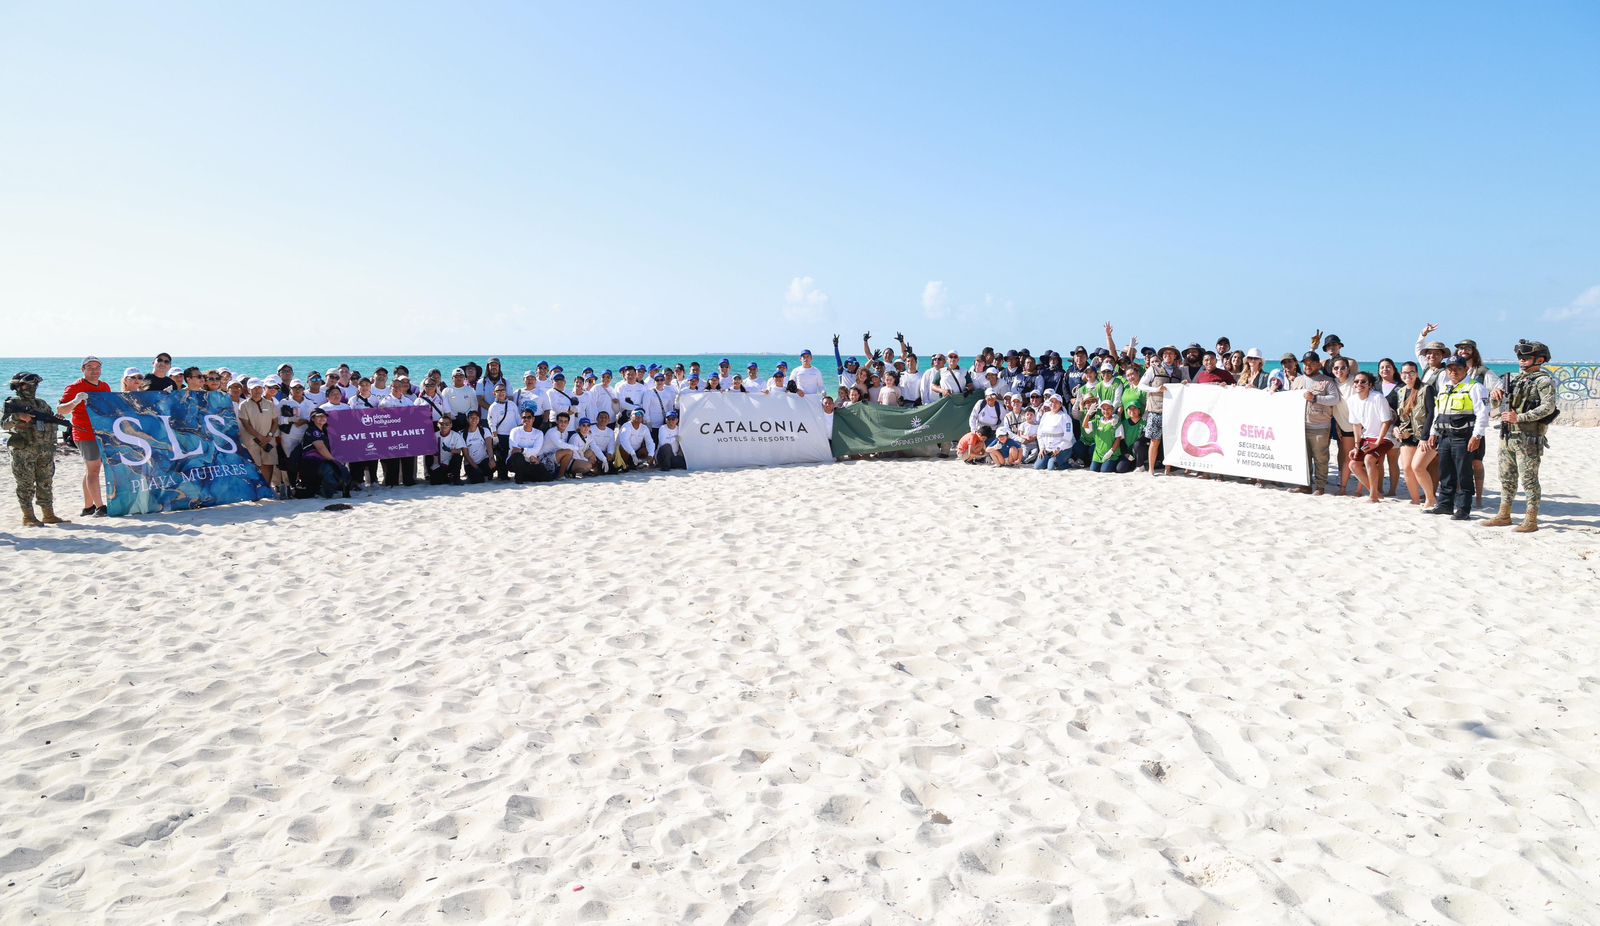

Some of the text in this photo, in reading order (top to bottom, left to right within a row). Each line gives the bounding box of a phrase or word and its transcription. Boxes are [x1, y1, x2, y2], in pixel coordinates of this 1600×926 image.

[373, 417, 401, 425] hollywood
[700, 420, 809, 435] CATALONIA
[341, 428, 425, 441] SAVE THE PLANET
[758, 435, 796, 443] RESORTS
[1240, 424, 1275, 440] SEMA
[112, 415, 238, 466] SLS
[890, 432, 945, 448] CARING BY DOING
[1237, 449, 1247, 457] DE
[1236, 457, 1293, 471] Y MEDIO AMBIENTE
[131, 464, 248, 493] PLAYA MUJERES
